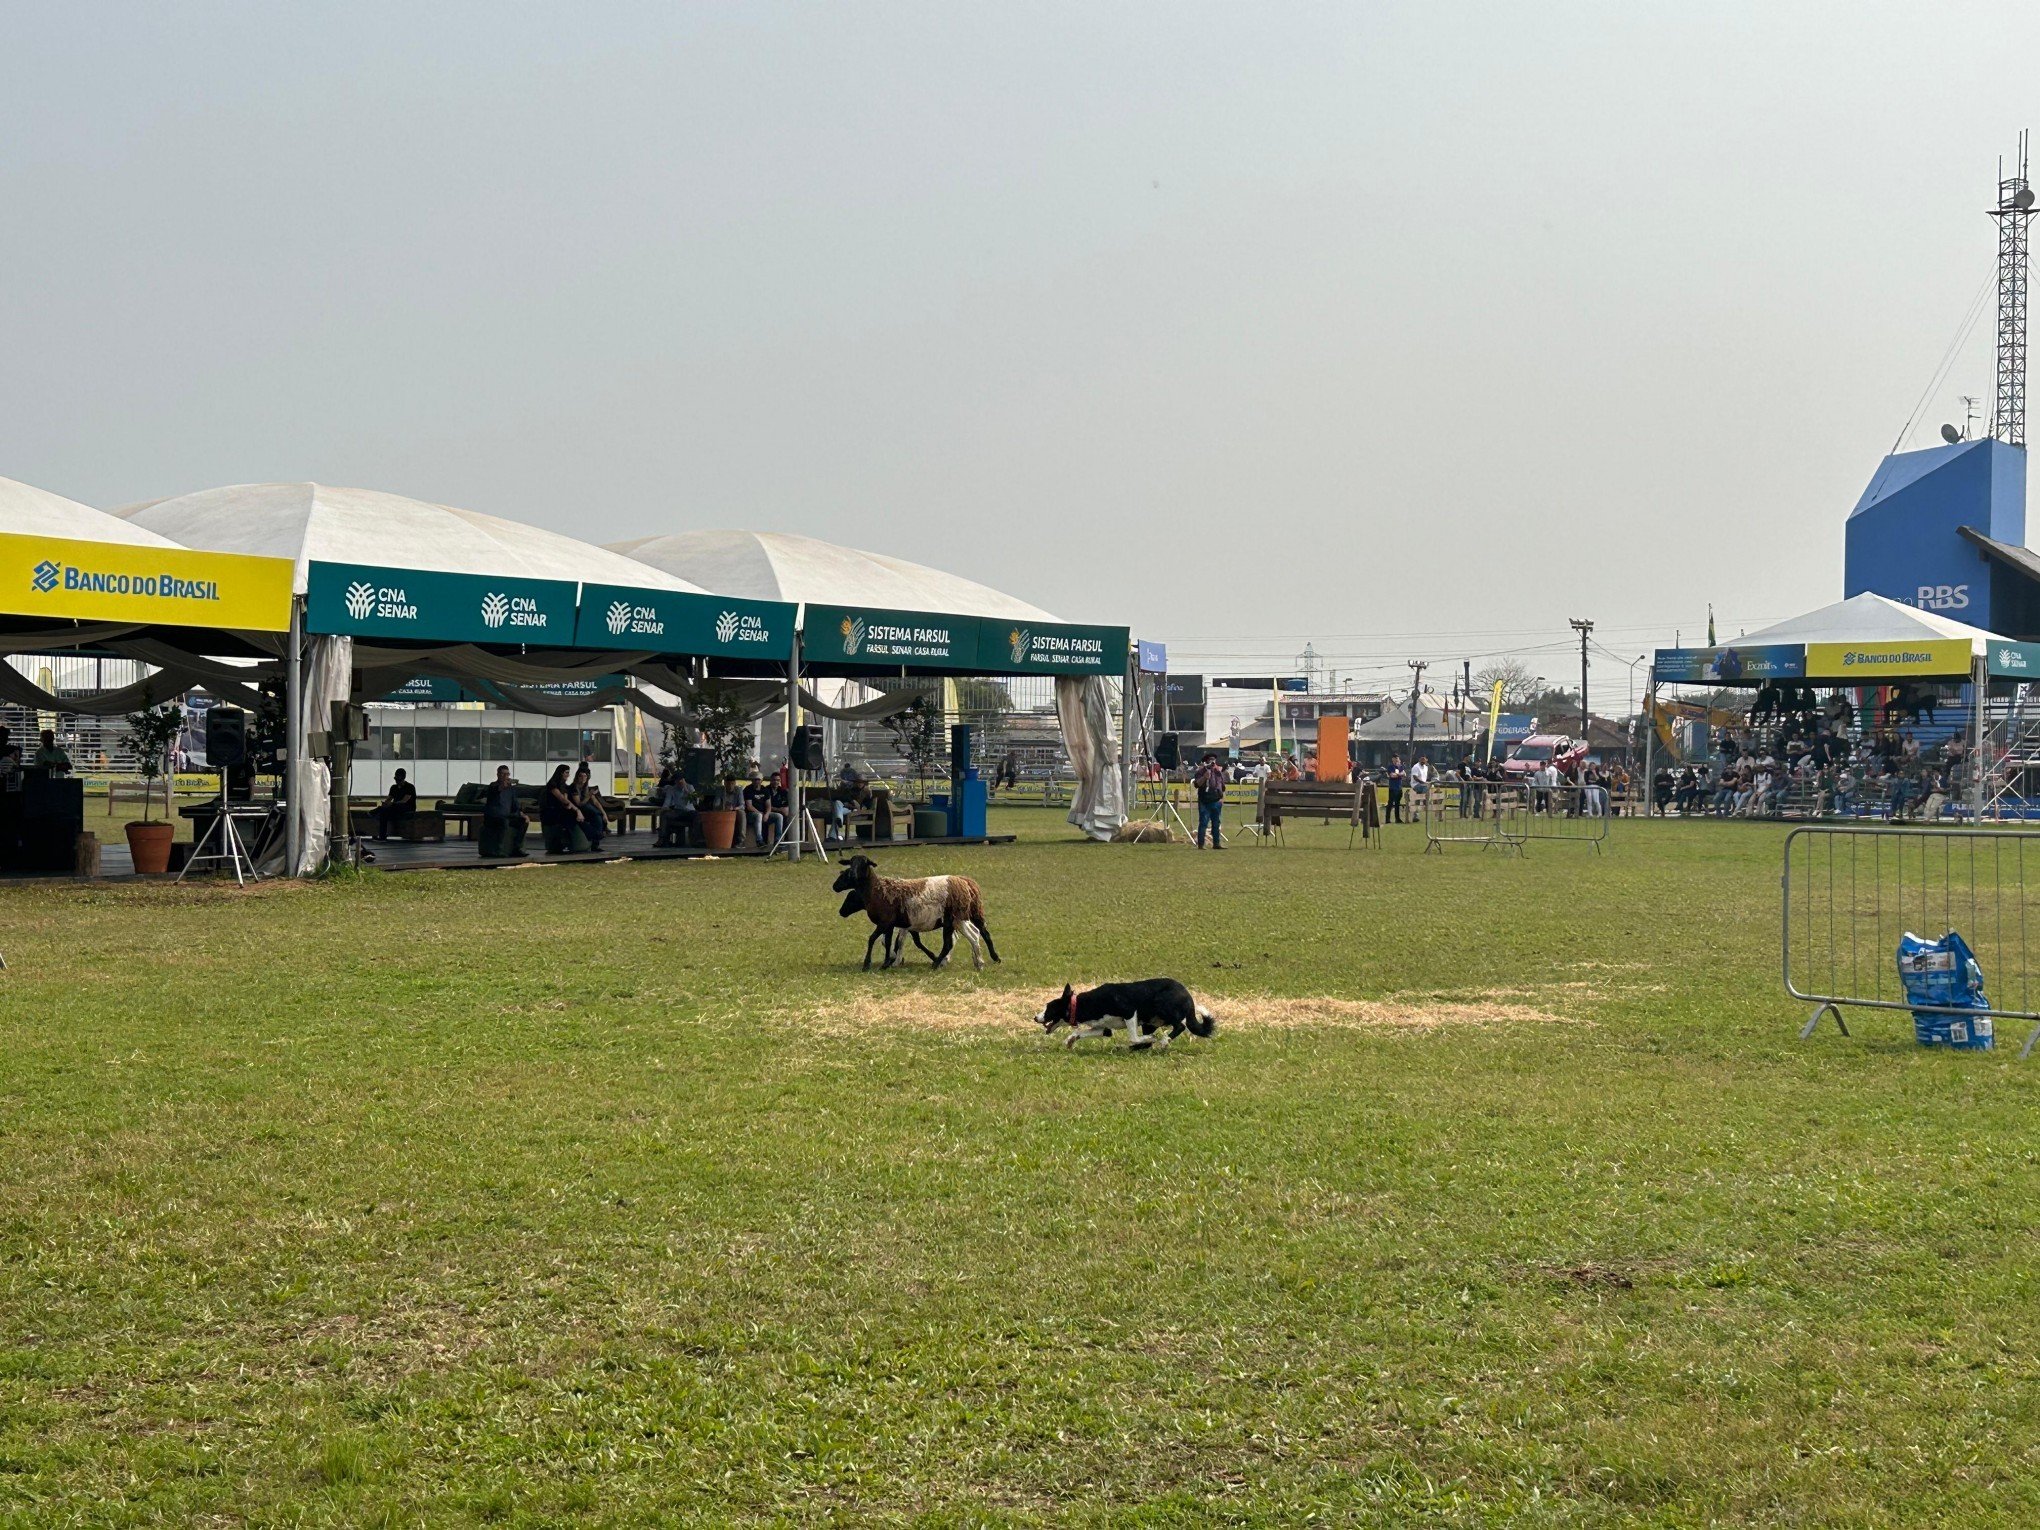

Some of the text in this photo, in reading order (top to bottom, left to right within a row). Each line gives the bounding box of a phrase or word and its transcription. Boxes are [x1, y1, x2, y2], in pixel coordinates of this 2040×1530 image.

[65, 567, 220, 600] BANCO DO BRASIL
[378, 587, 406, 603] CNA
[1917, 584, 1969, 609] RBS
[377, 604, 417, 619] SENAR
[511, 598, 537, 612] CNA
[510, 613, 547, 627] SENAR
[633, 606, 656, 620] CNA
[631, 620, 664, 635] SENAR
[740, 616, 762, 628] CNA
[738, 629, 769, 642] SENAR
[868, 625, 950, 643] SISTEMA FARSUL
[866, 644, 889, 654] FARSUL
[891, 645, 912, 655] SENAR
[914, 647, 930, 656] CASA
[1032, 636, 1103, 652] SISTEMA FARSUL
[1858, 652, 1933, 664] BANCO DO BRASIL
